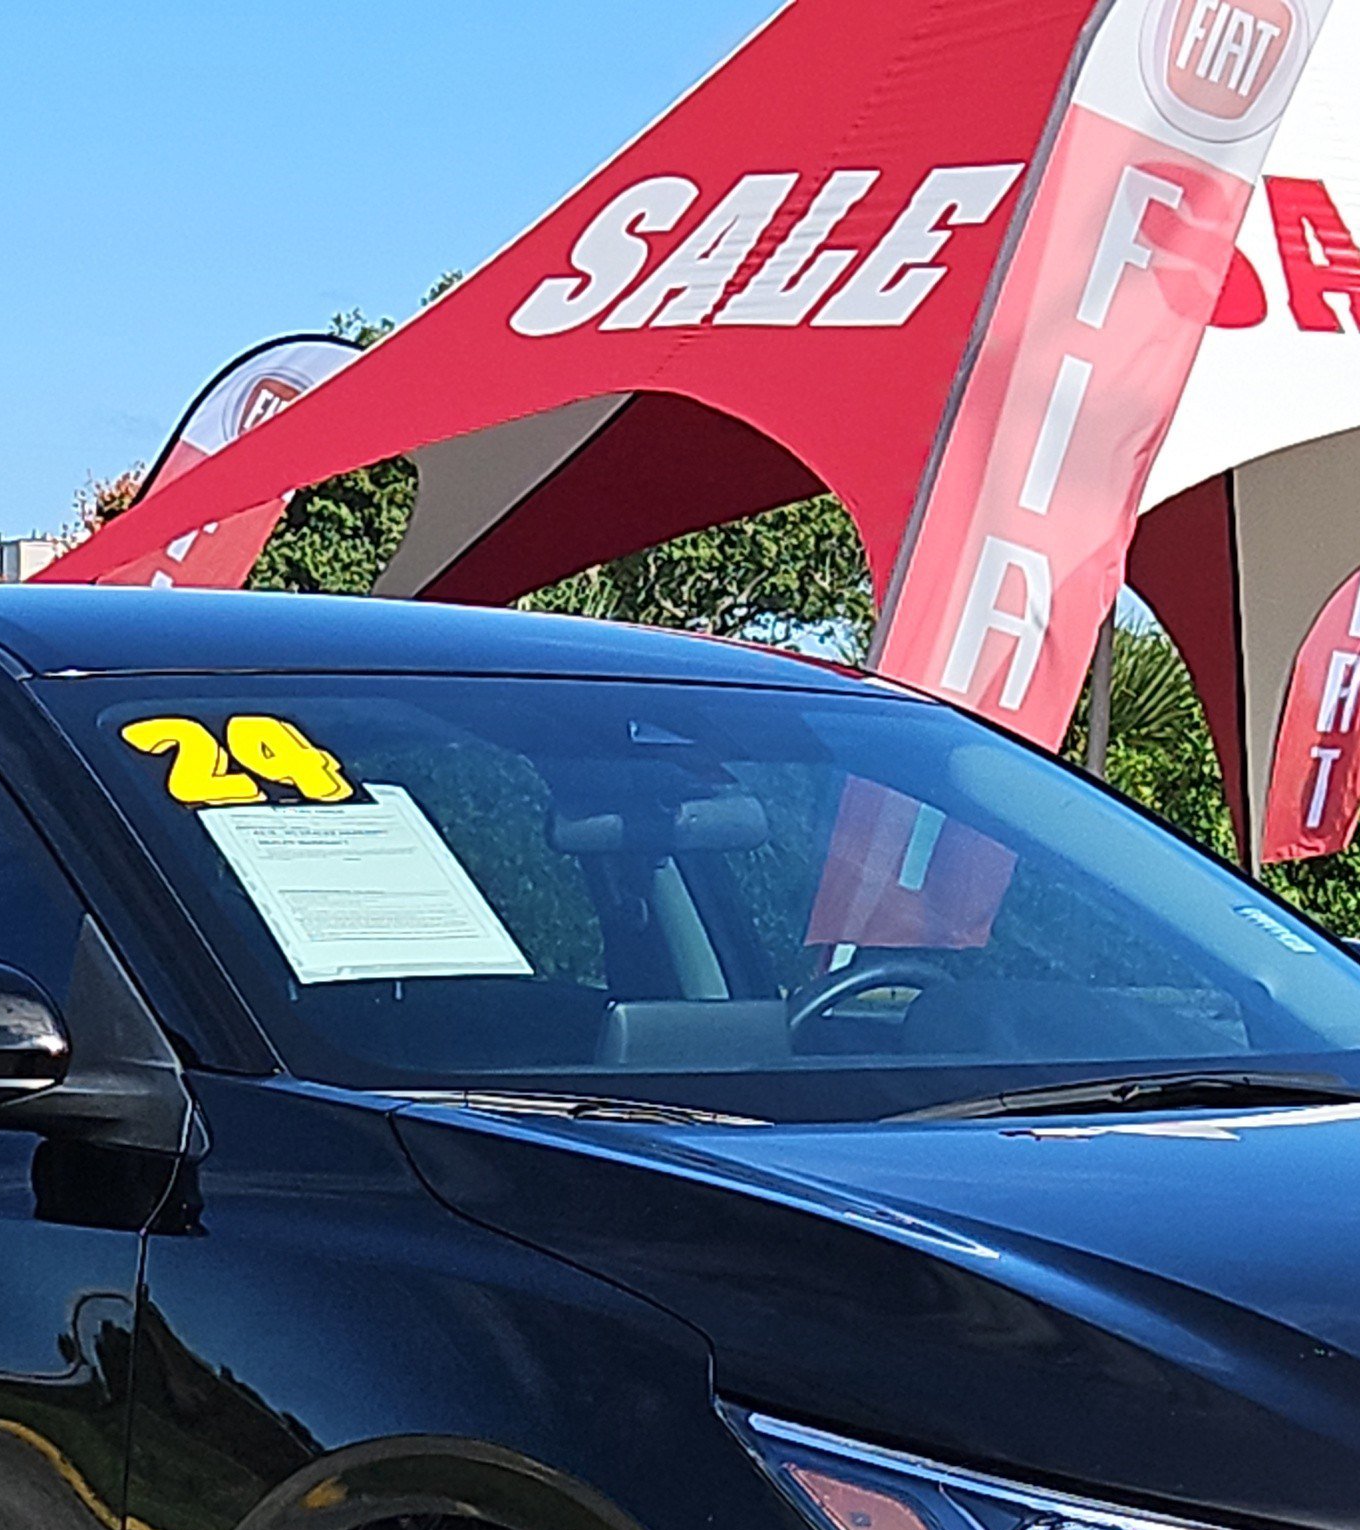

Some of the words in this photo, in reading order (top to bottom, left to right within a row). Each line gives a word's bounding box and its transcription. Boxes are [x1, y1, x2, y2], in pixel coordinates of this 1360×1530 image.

[1175, 0, 1281, 97] FIAT
[508, 162, 1025, 338] SALE
[119, 712, 354, 807] 24
